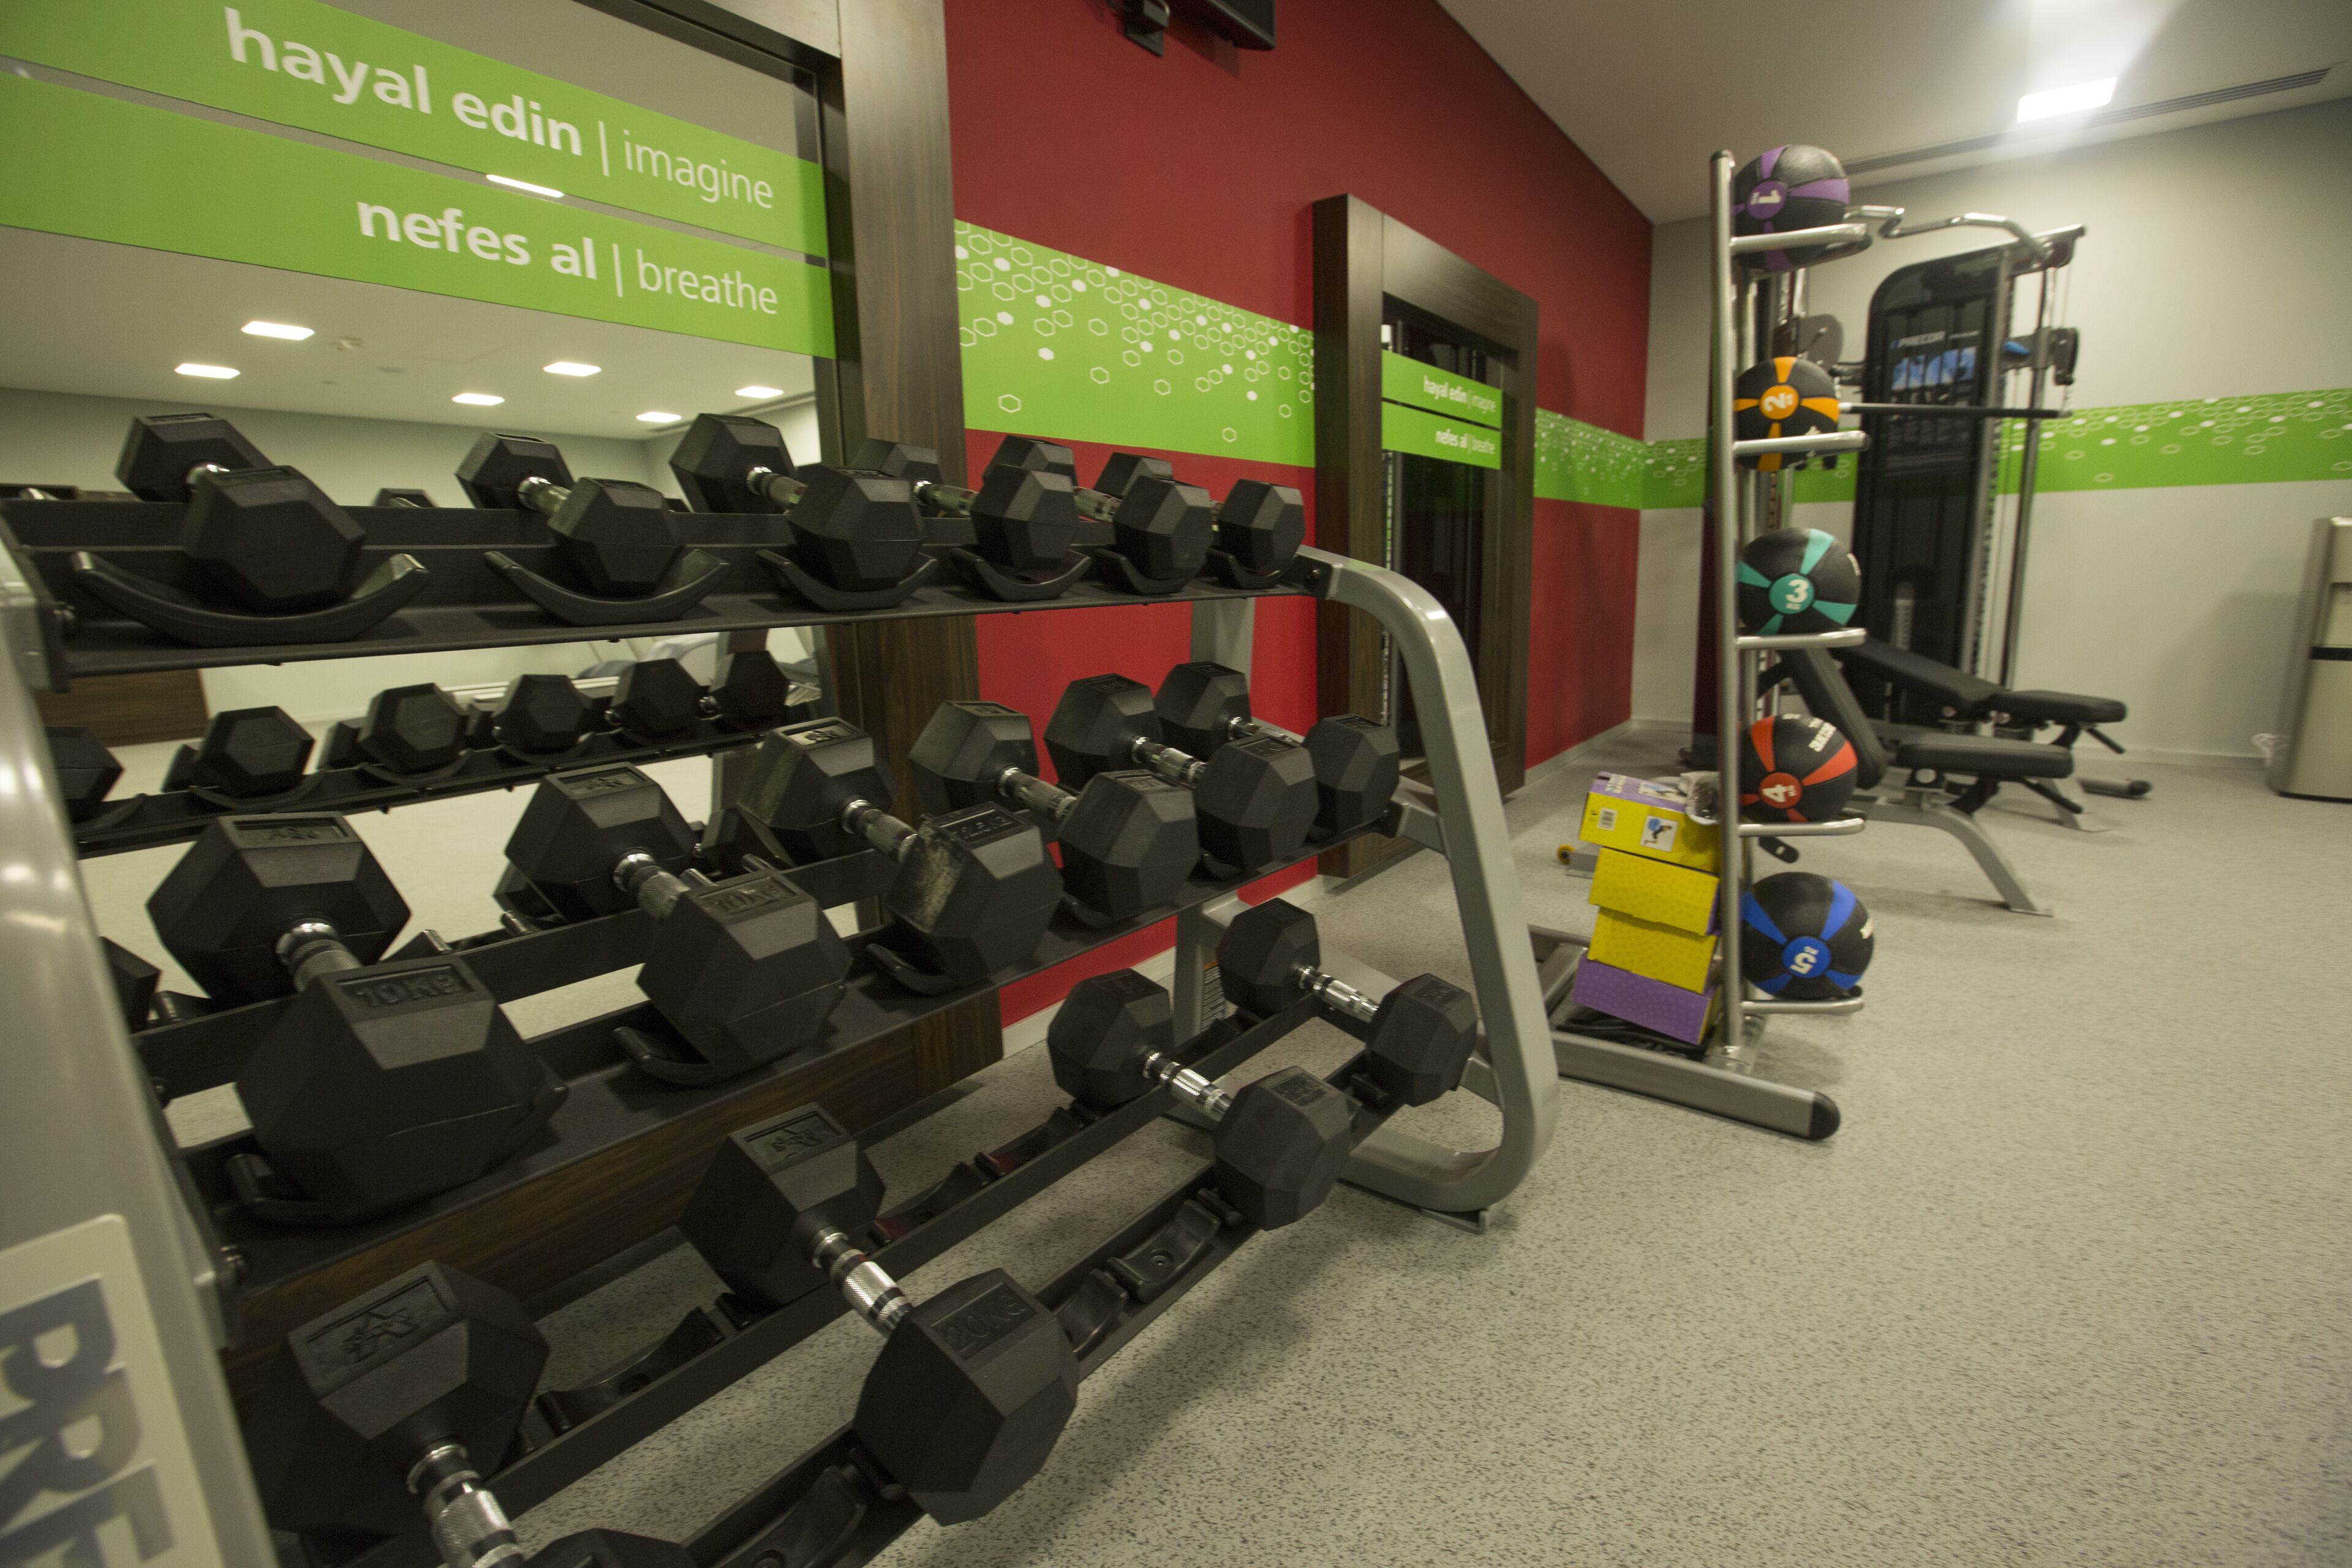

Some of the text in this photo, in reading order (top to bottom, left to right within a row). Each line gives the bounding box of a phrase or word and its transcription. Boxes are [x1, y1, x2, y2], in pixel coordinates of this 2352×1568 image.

[224, 6, 773, 208] hayal edin imagine
[356, 202, 778, 314] nefes al breathe
[1763, 393, 1787, 412] 2
[1785, 579, 1809, 603] 3
[1762, 784, 1787, 802] 4
[1790, 952, 1818, 974] 5
